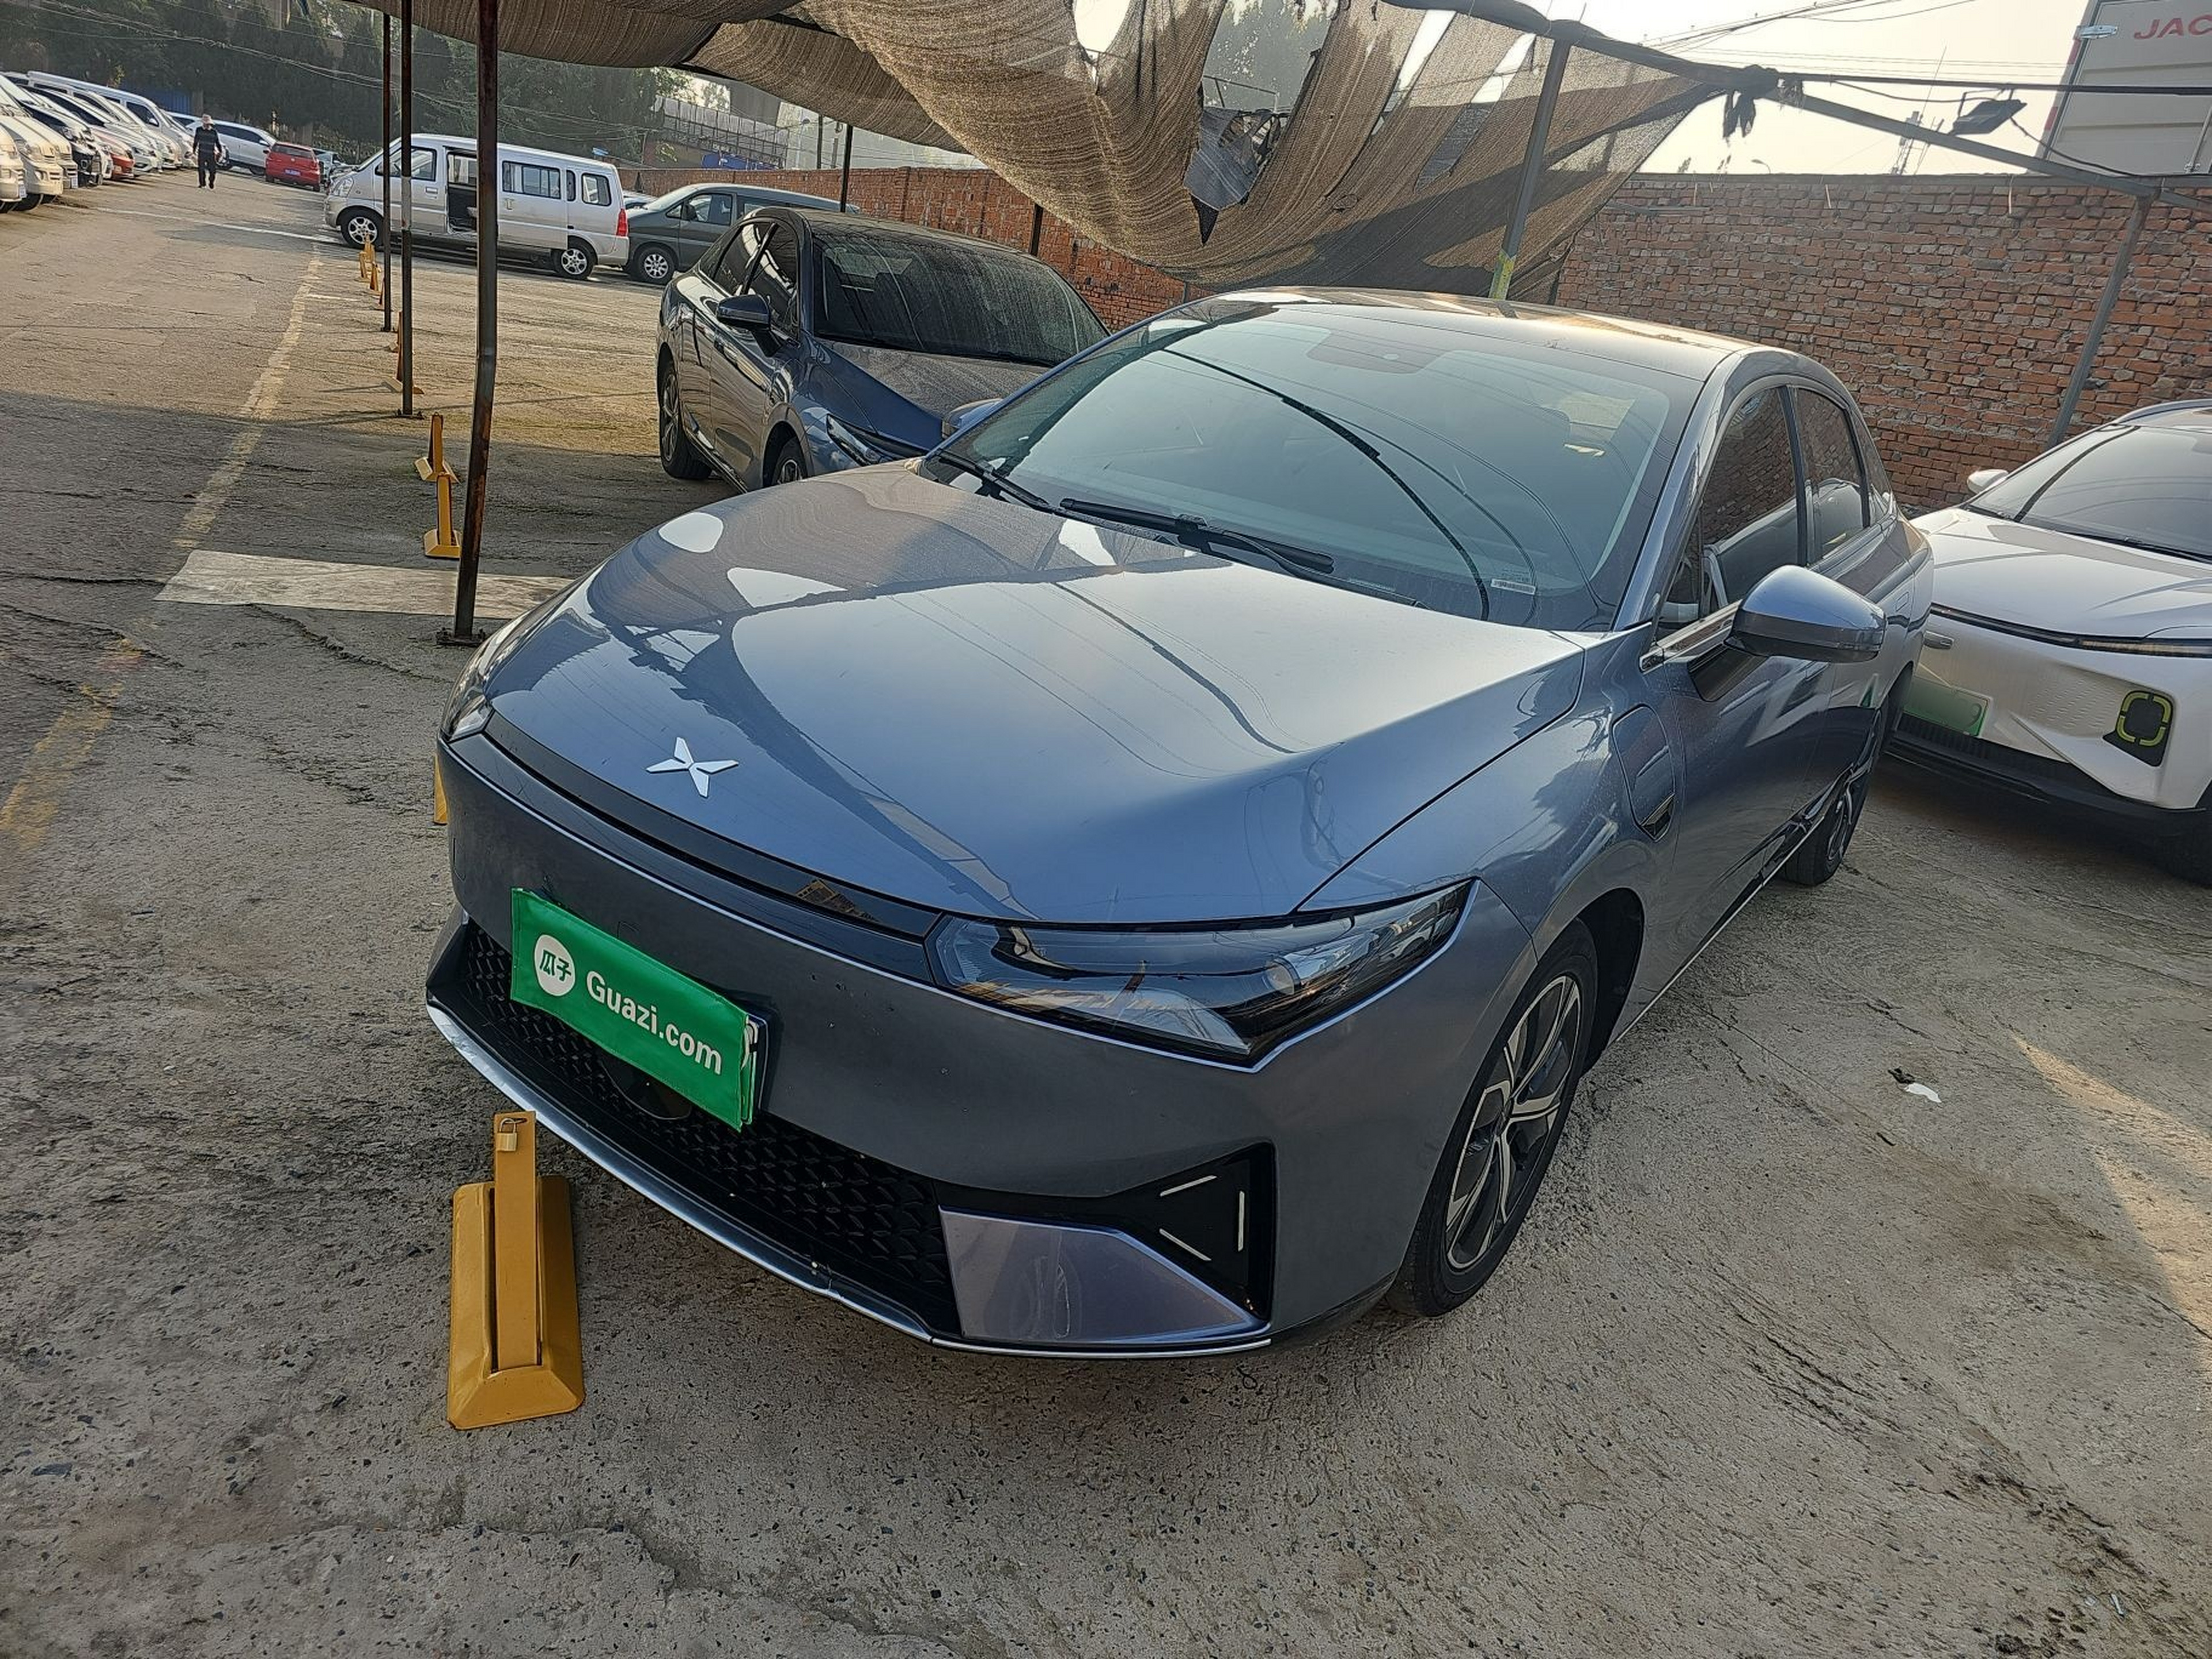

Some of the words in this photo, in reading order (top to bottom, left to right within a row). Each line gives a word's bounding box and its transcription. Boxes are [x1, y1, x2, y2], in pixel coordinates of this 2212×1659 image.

[2134, 14, 2212, 39] JAC
[539, 949, 571, 982] 瓜子
[586, 970, 722, 1075] Guazi.com
